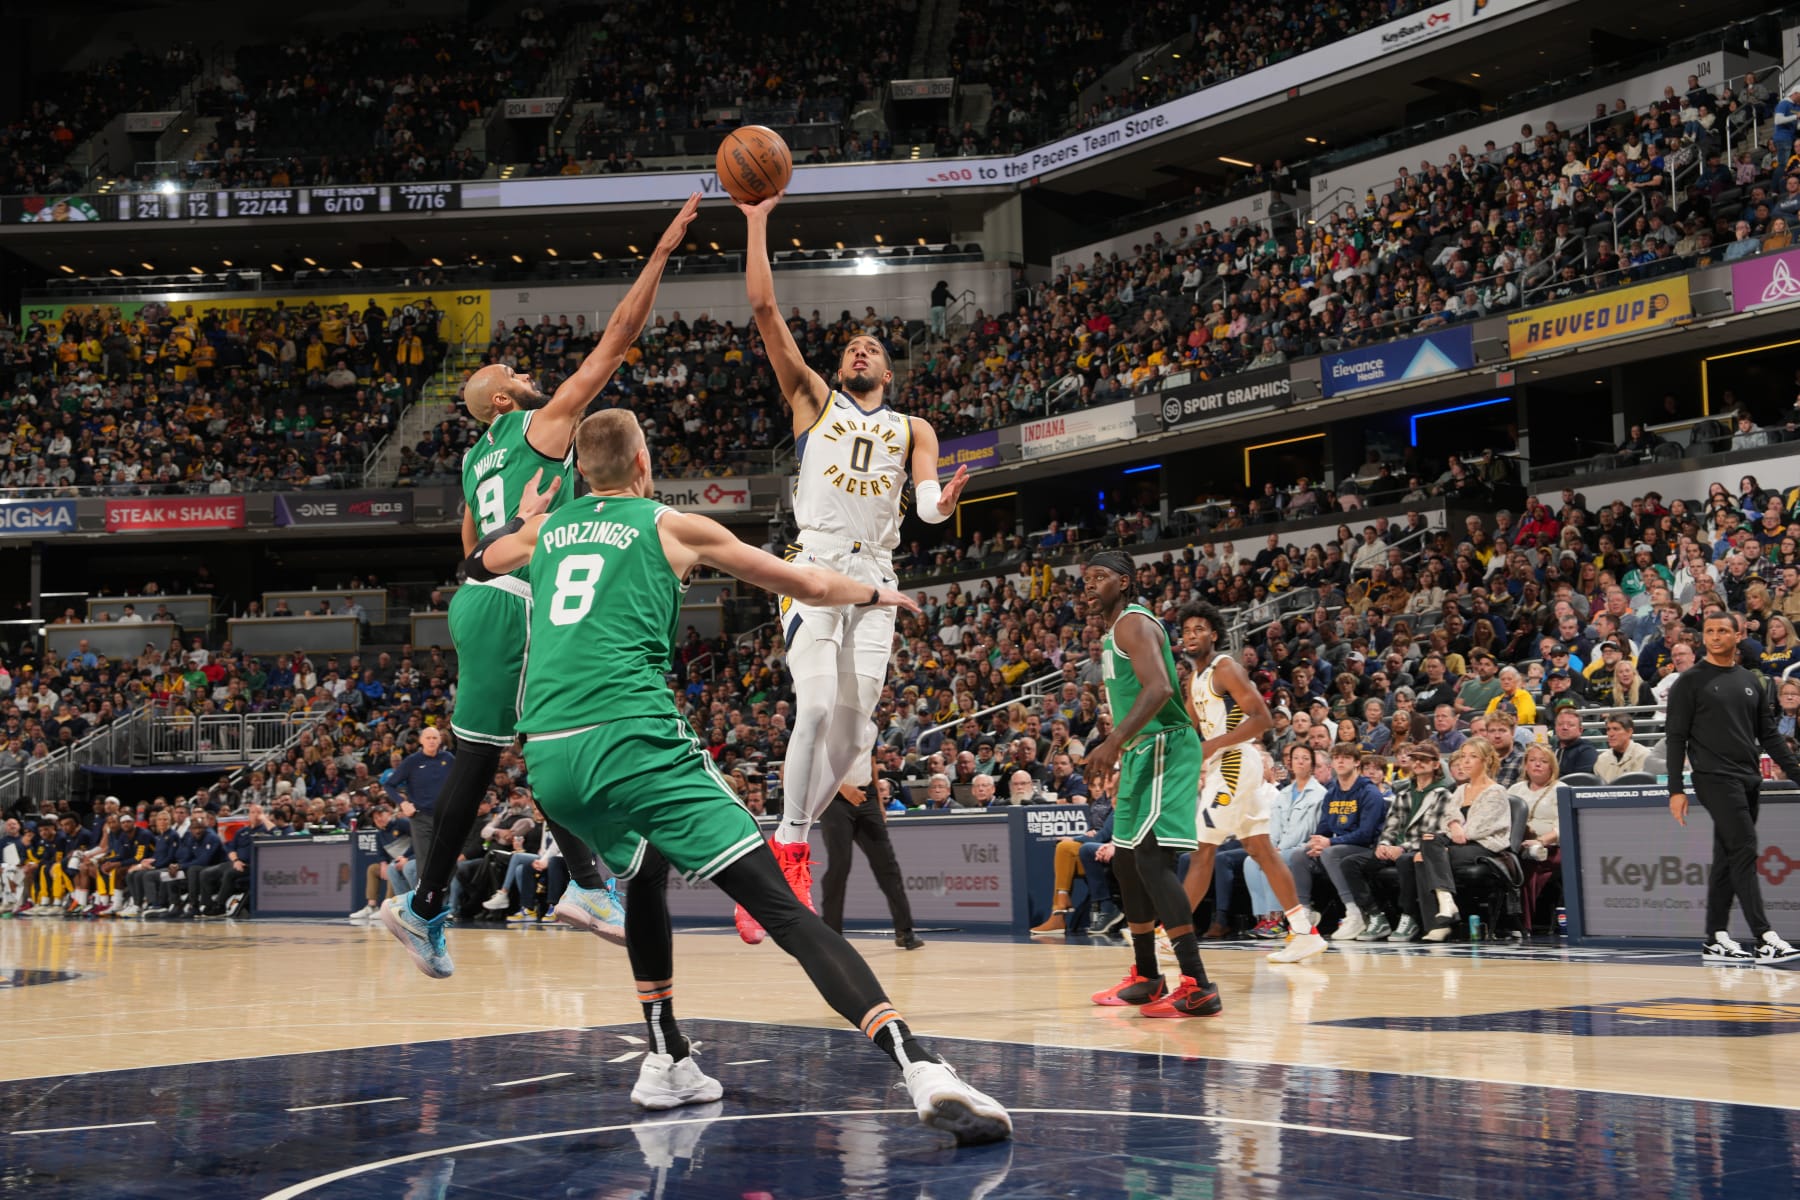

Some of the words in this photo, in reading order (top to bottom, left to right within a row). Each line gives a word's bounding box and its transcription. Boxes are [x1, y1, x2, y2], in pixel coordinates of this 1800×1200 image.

[1697, 60, 1711, 78] 104
[932, 83, 951, 95] 206
[508, 103, 527, 115] 204
[978, 166, 998, 180] to
[1004, 161, 1029, 179] the
[1031, 144, 1079, 170] Pacers
[1083, 129, 1121, 153] Team
[1125, 114, 1169, 138] Store.
[189, 193, 208, 201] AST
[234, 191, 260, 200] FIELD
[261, 190, 292, 199] GOALS
[312, 188, 337, 197] FREE
[338, 186, 377, 196] THROWS
[399, 185, 437, 195] 3-POINT
[439, 184, 452, 193] FG
[188, 202, 208, 217] 12
[238, 201, 288, 216] 22/44
[324, 197, 365, 212] 6/10
[406, 194, 446, 209] 7/16
[138, 204, 160, 218] 24
[456, 295, 482, 305] 101
[1527, 307, 1611, 344] REVVED
[1615, 299, 1645, 325] UP
[1332, 359, 1384, 378] Elevance
[1357, 369, 1385, 382] Health
[1183, 393, 1223, 415] SPORT
[1226, 379, 1291, 406] GRAPHICS
[823, 420, 901, 455] INDIANA
[1023, 418, 1066, 443] INDIANA
[850, 435, 874, 473] 0
[957, 446, 995, 464] fitness
[473, 448, 508, 480] WHITE
[823, 464, 892, 496] PACERS
[371, 502, 403, 513] 100.9
[475, 474, 506, 536] 9
[110, 507, 165, 524] STEAK
[180, 505, 237, 522] SHAKE
[543, 521, 640, 554] PORZINGIS
[549, 553, 606, 626] 8
[1026, 810, 1087, 823] INDIANA
[1041, 821, 1088, 836] BOLD
[962, 843, 1000, 863] Visit
[1600, 856, 1713, 892] KeyBa
